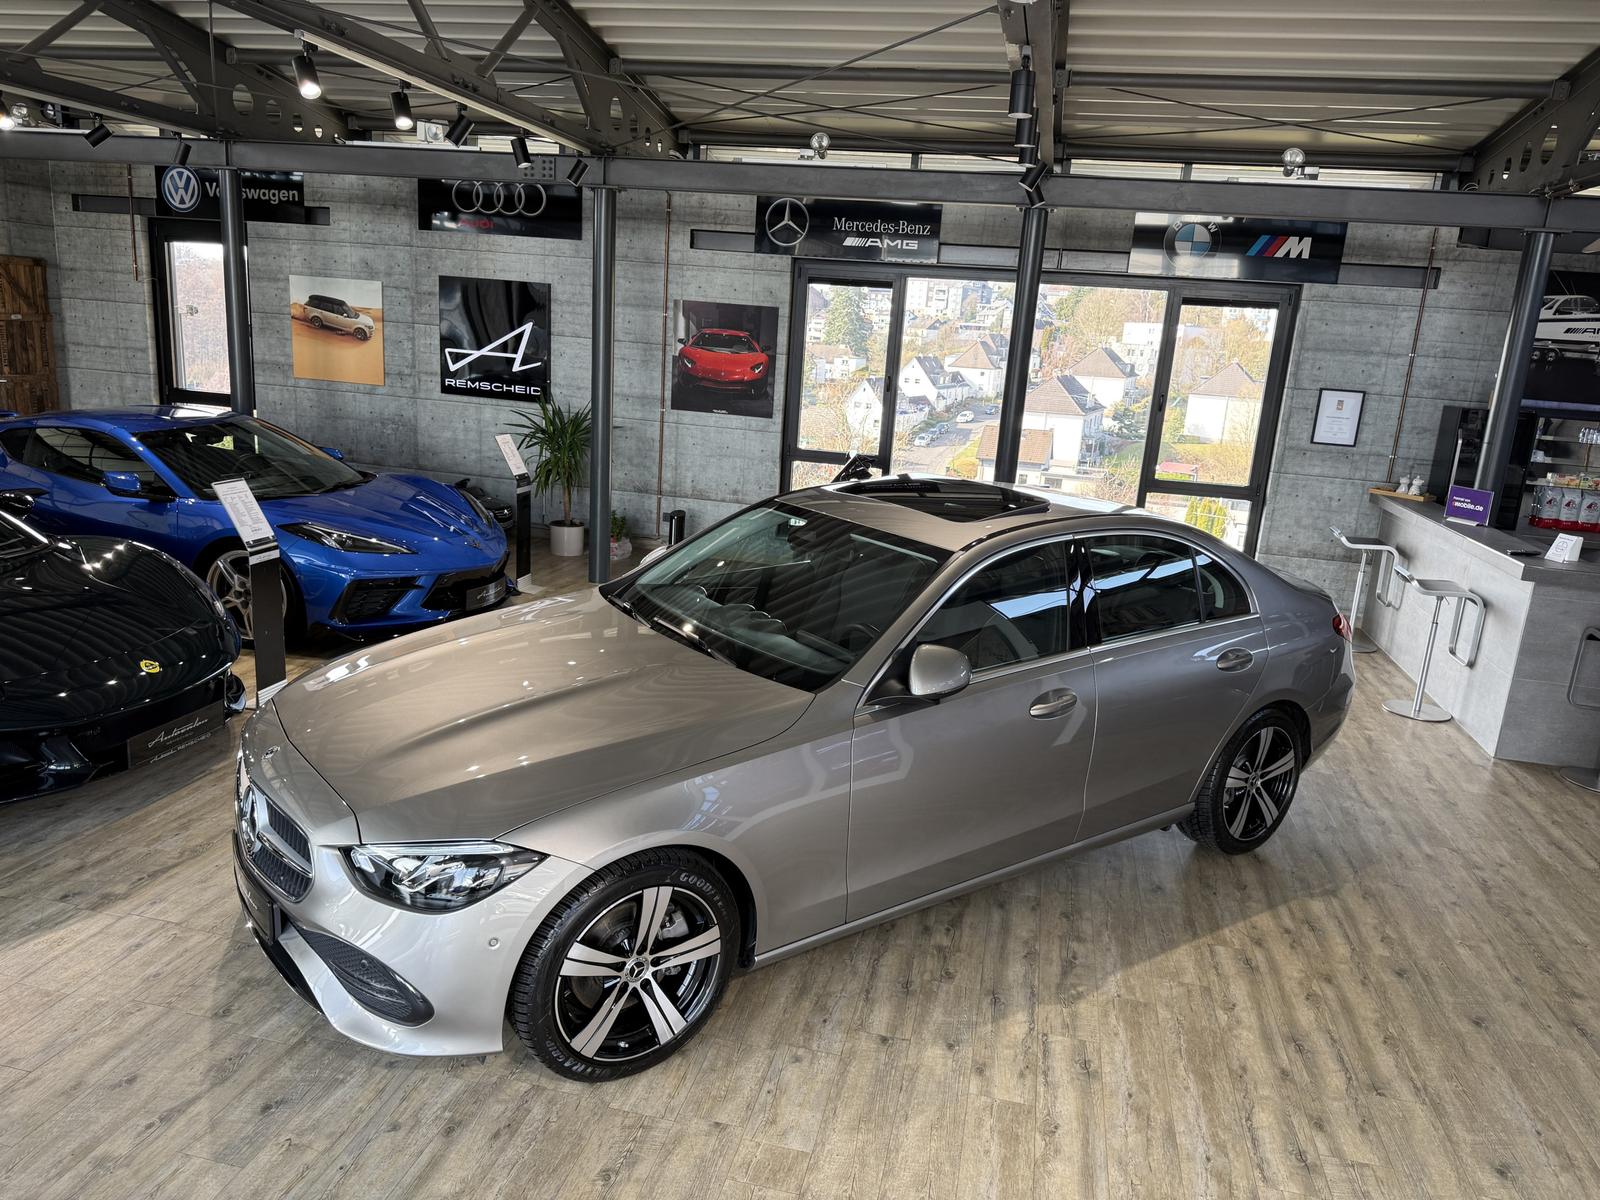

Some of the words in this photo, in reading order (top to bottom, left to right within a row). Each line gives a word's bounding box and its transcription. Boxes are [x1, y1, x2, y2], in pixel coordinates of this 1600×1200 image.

[205, 181, 299, 204] Vswagen
[833, 217, 931, 236] Mercedes-Benz
[865, 238, 919, 250] AMG
[445, 378, 542, 396] REMSCHEID
